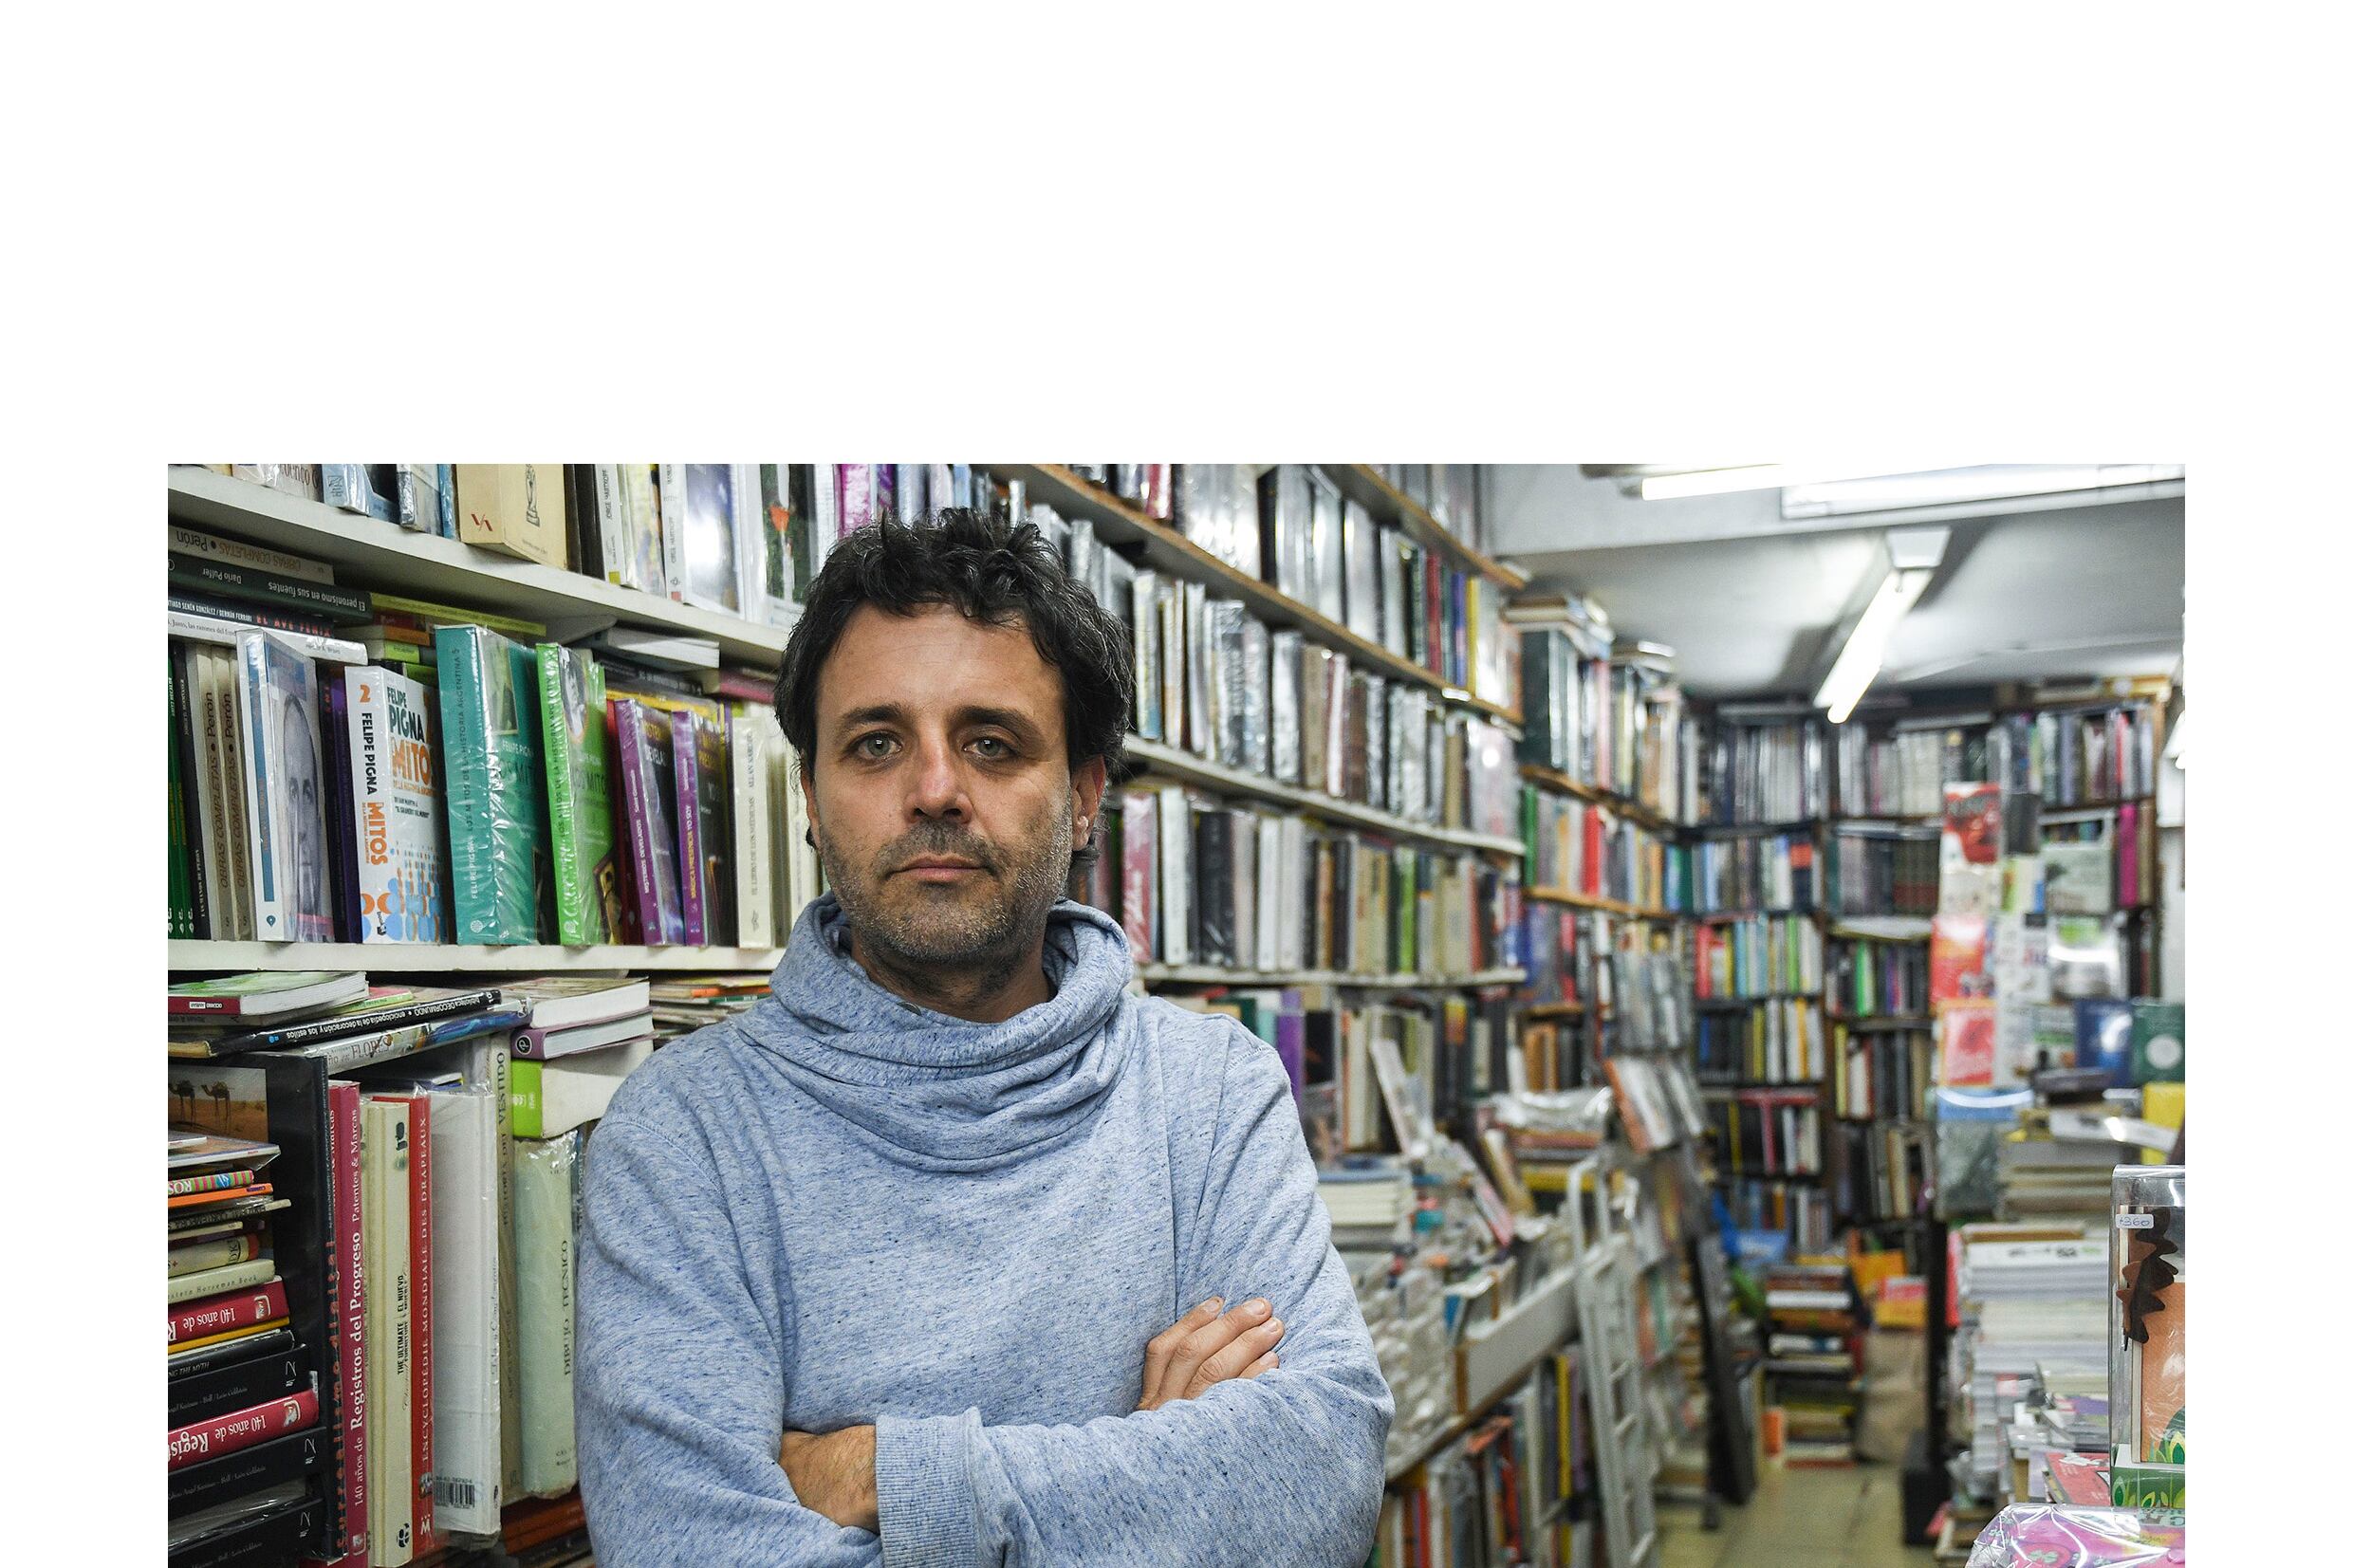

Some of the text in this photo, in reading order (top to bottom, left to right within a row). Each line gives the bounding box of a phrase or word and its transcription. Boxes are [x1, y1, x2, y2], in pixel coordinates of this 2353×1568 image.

[176, 530, 208, 551] Perón
[219, 543, 271, 565] COMPLETAS
[269, 581, 366, 612] El peronismo en sus fuentes
[360, 684, 371, 703] 2
[387, 686, 406, 708] FELIPE
[454, 655, 465, 708] ARGENTINA
[389, 706, 425, 743] PIGNA
[457, 710, 468, 753] HISTORIA
[361, 712, 377, 796] FELIPE PIGNA
[205, 692, 229, 888] OBRAS COMPLETAS Perón
[224, 692, 247, 888] OBRAS COMPLETAS Perón
[367, 802, 388, 866] MITOS
[370, 1009, 406, 1024] enciclopedia
[286, 1028, 307, 1040] estilos
[496, 1052, 507, 1125] VESTIDO
[349, 1109, 361, 1223] Patentes & Marcas
[419, 1117, 428, 1202] DRAPEAUX
[349, 1231, 363, 1311] Progreso
[420, 1248, 429, 1332] MONDIALE
[197, 1313, 218, 1327] años
[220, 1307, 236, 1323] 140
[397, 1302, 404, 1312] EL
[183, 1318, 195, 1332] de
[349, 1316, 362, 1342] del
[397, 1322, 405, 1359] ULTIMATE
[564, 1319, 572, 1375] DIBUJO
[349, 1347, 365, 1430] Registros
[420, 1337, 430, 1461] ENCYCLOPÉDIE
[214, 1426, 227, 1441] de
[228, 1419, 250, 1435] años
[251, 1414, 267, 1430] 140
[353, 1437, 363, 1450] de
[353, 1451, 364, 1484] años
[354, 1485, 364, 1506] 140
